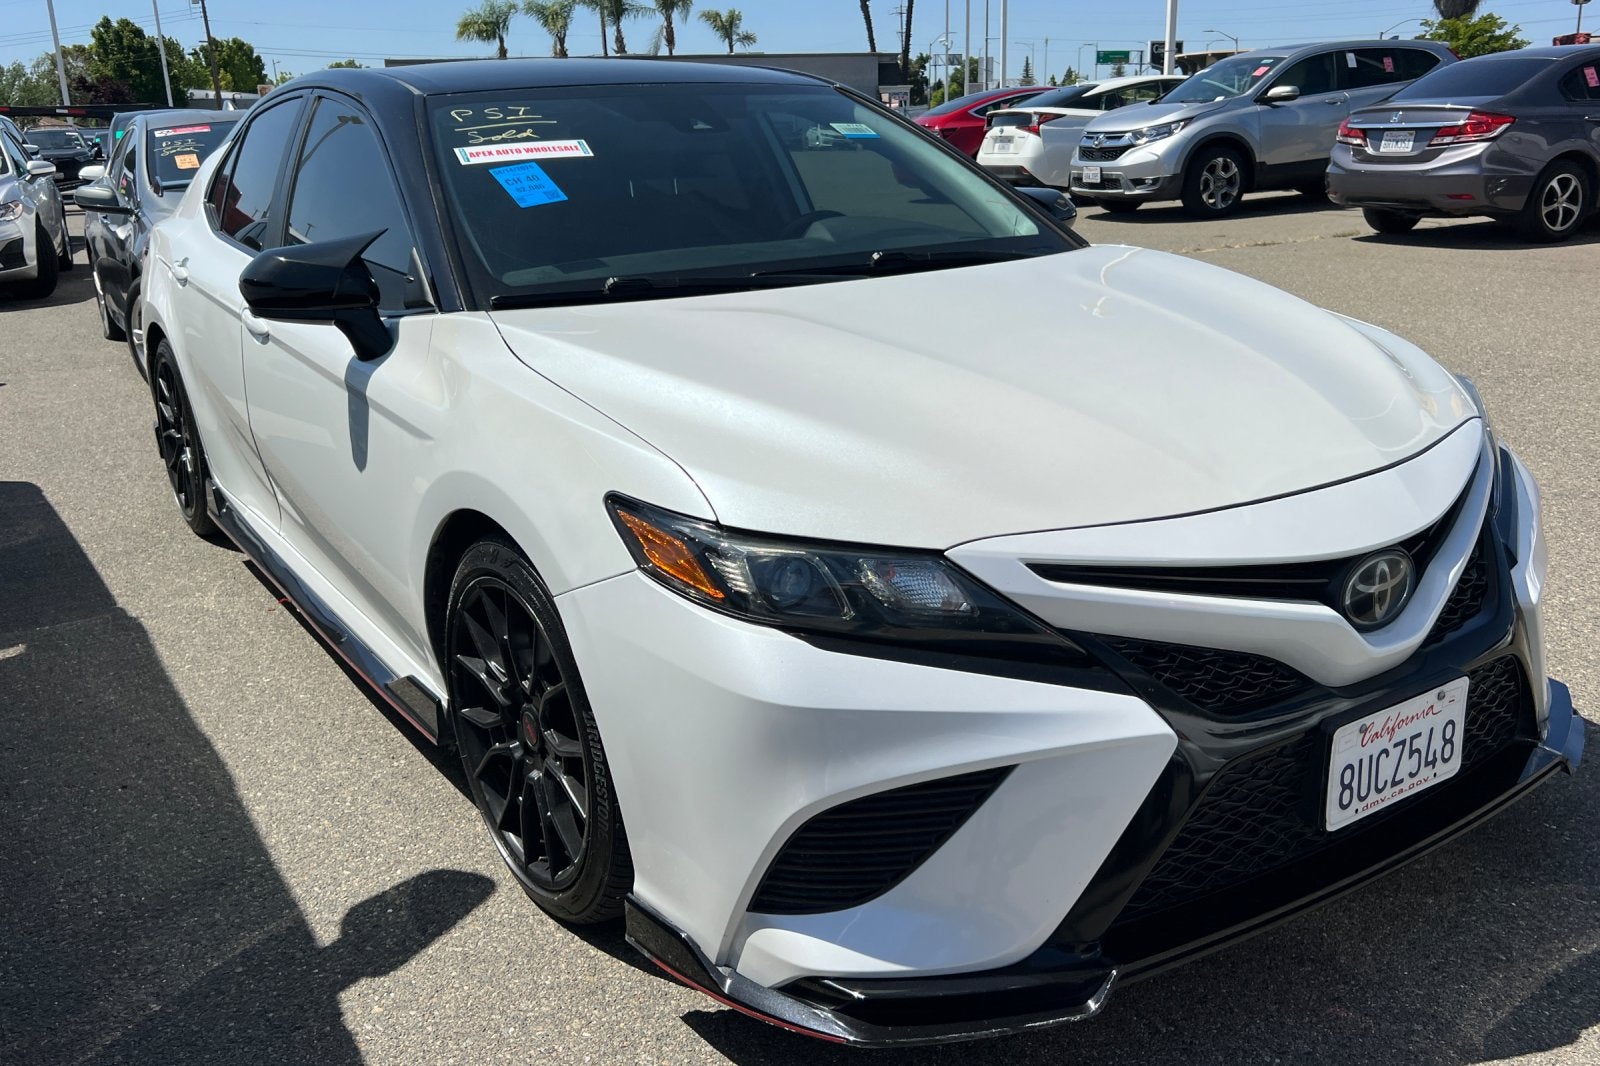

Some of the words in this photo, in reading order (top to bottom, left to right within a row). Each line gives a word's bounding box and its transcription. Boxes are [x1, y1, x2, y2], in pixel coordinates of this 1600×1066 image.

[469, 150, 495, 159] APEX
[496, 148, 522, 156] AUTO
[523, 145, 581, 154] WHOLESALE
[1360, 703, 1442, 748] California
[582, 710, 610, 842] BRIDGESTONE
[1338, 719, 1456, 811] 8UCZ548
[1361, 775, 1430, 812] dmv.ca.gov
